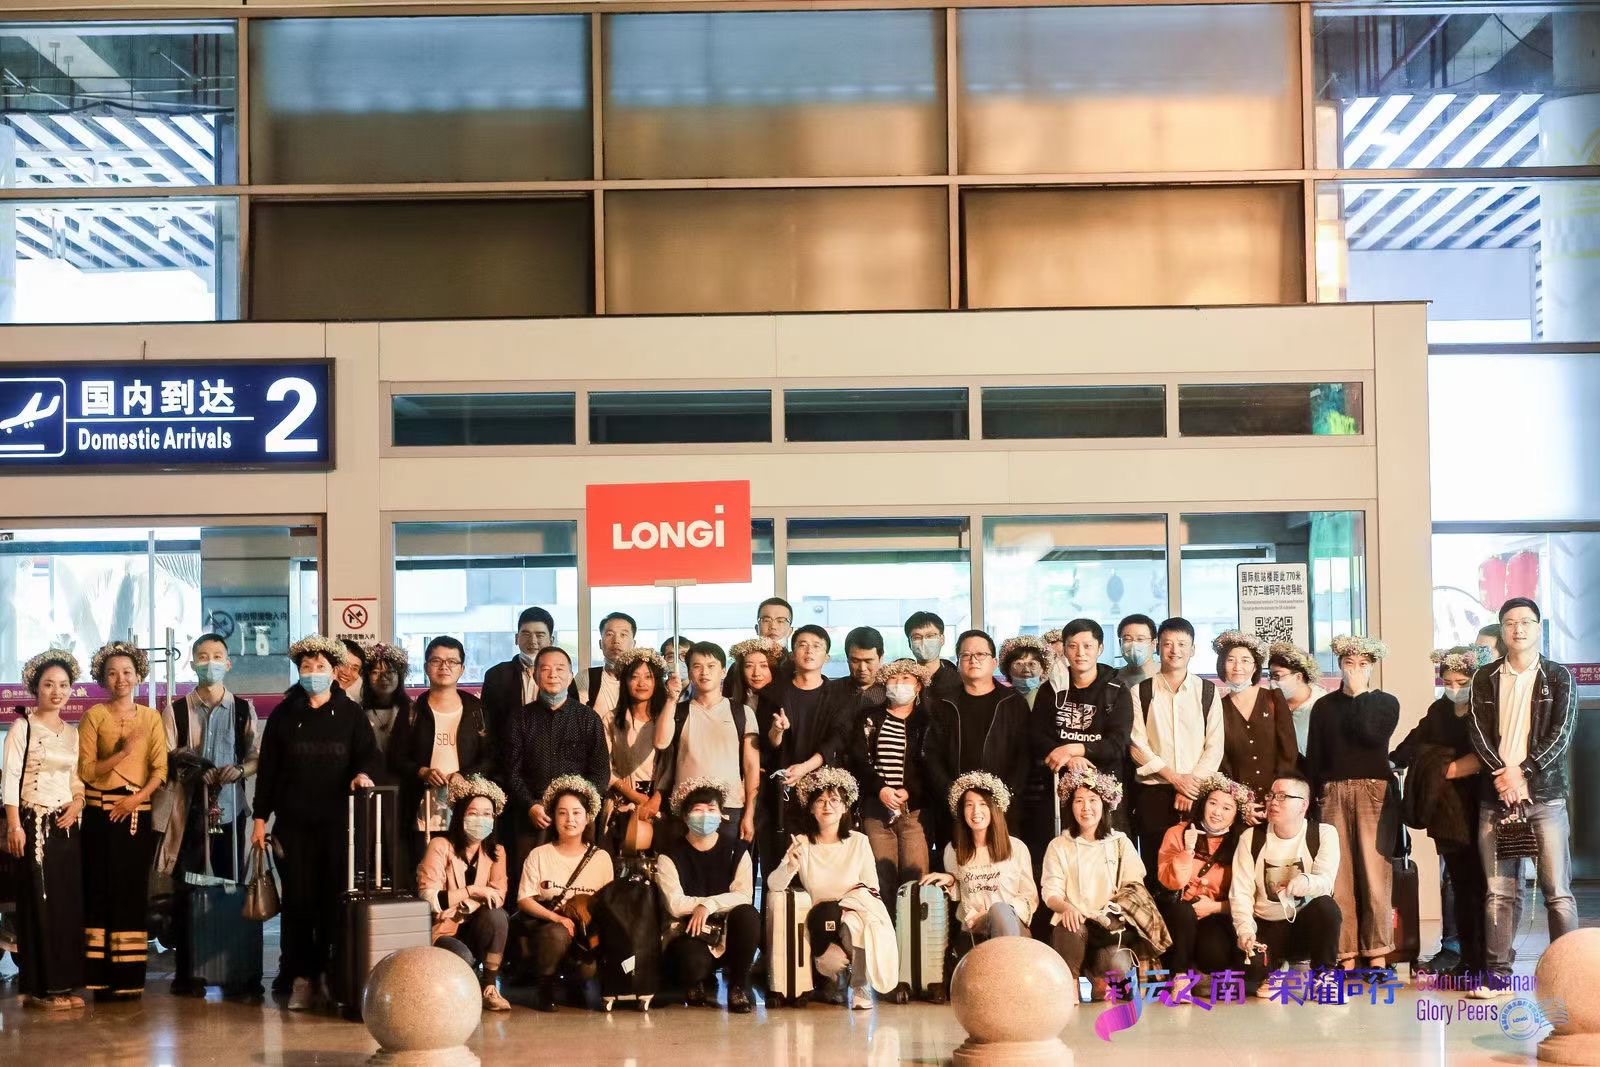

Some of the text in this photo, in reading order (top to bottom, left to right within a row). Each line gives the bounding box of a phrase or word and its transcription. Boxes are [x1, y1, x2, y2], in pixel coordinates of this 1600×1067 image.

[81, 379, 236, 416] 国内到达
[265, 377, 318, 452] 2
[78, 426, 232, 451] Domestic Arrivals
[612, 504, 725, 550] LONGi
[1060, 729, 1102, 742] balance
[963, 871, 1001, 883] Strength
